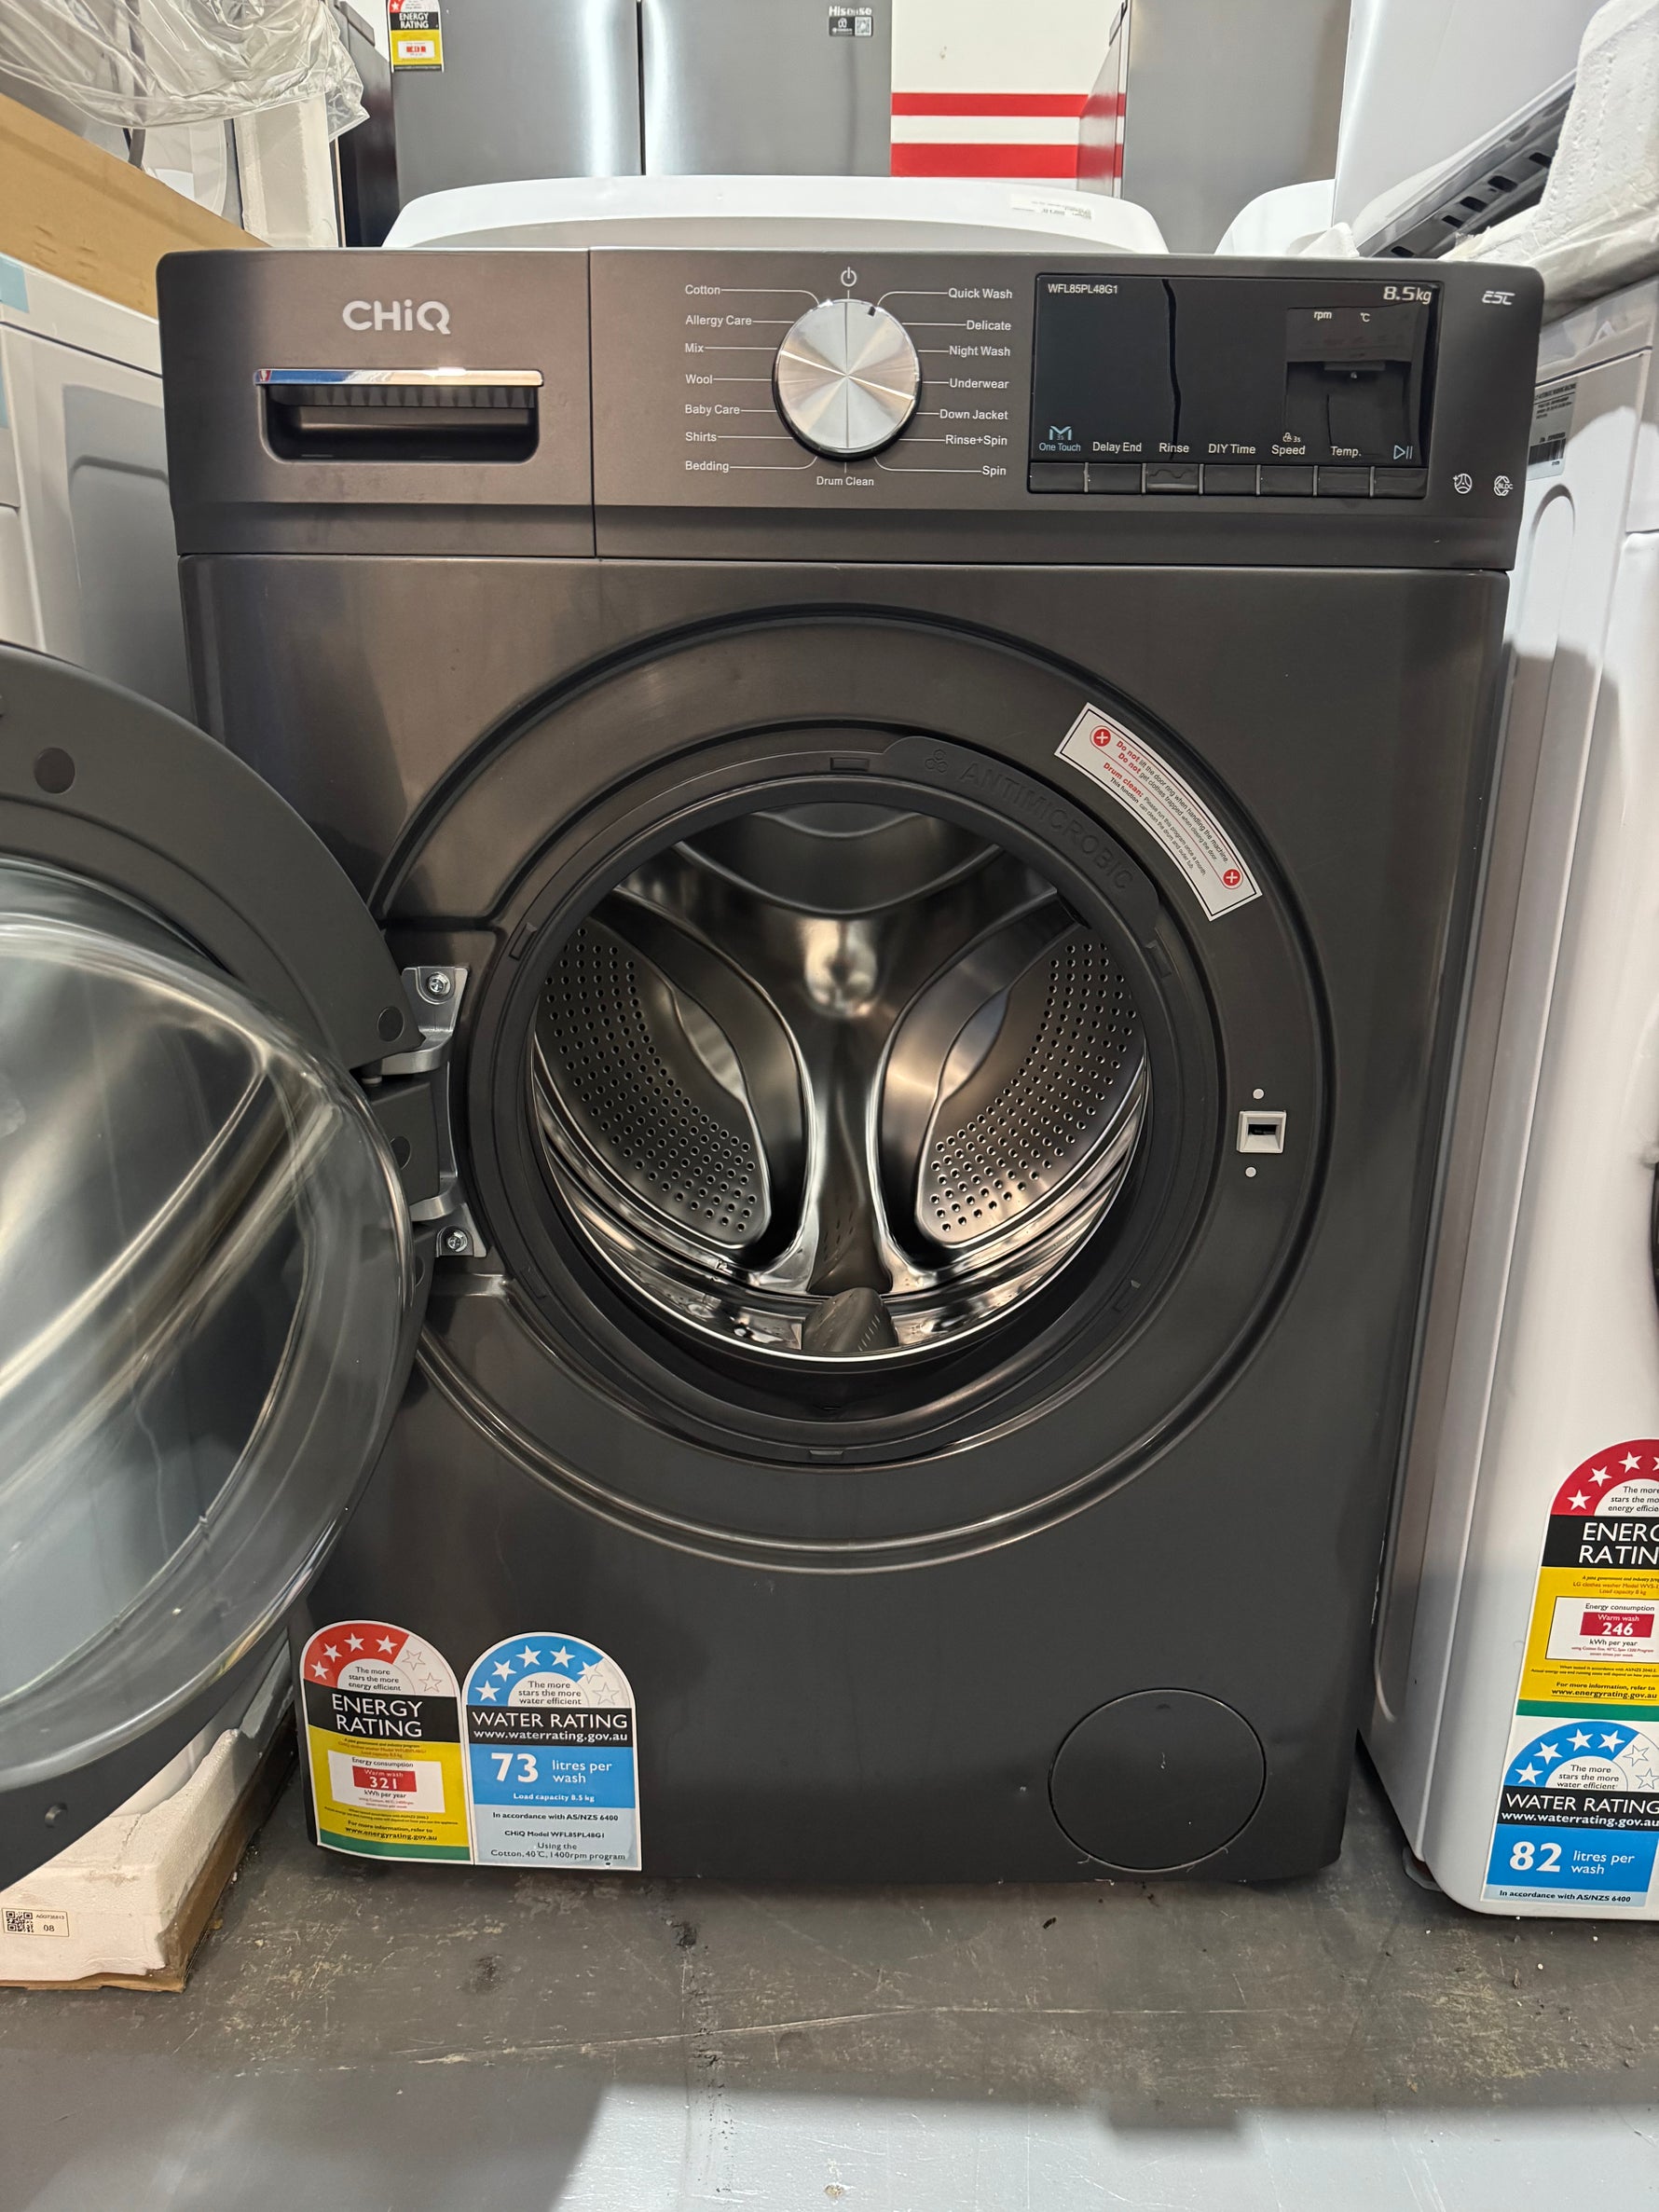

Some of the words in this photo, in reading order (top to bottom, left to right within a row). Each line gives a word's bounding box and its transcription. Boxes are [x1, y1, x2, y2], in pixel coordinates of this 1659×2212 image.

[401, 21, 429, 29] RATING
[685, 284, 720, 295] Cotton
[948, 289, 980, 300] Quick
[981, 289, 1013, 299] Wash
[1048, 283, 1117, 294] WFL85PL48G1
[1383, 286, 1432, 304] 8.5kg
[342, 299, 451, 335] CHiQ
[685, 315, 722, 328] Allergy
[725, 315, 752, 326] Care
[1314, 310, 1332, 321] rpm
[967, 320, 1011, 331] Delicate
[685, 343, 704, 353] Mix
[949, 346, 977, 357] Night
[980, 346, 1010, 357] Wash
[685, 375, 713, 384] Wool
[949, 378, 1009, 389] Underwear
[685, 405, 712, 417] Baby
[715, 405, 740, 415] Care
[939, 409, 970, 419] Down
[972, 410, 1008, 420] Jacket
[685, 433, 717, 442] Shirts
[945, 434, 1008, 447] Rinse+Spin
[1039, 443, 1056, 451] One
[1058, 443, 1081, 451] Touch
[1092, 441, 1120, 454] Delay
[1122, 442, 1142, 452] End
[1159, 443, 1190, 453] Rinse
[1208, 444, 1228, 454] DIY
[1230, 444, 1255, 454] Time
[1271, 445, 1306, 457] Speed
[1331, 446, 1362, 458] Temp.
[685, 460, 729, 474] Bedding
[982, 466, 1007, 477] Spin
[816, 476, 843, 486] Drum
[845, 476, 874, 487] Clean
[1104, 763, 1122, 779] Drum
[1122, 778, 1144, 798] clean:
[1118, 753, 1129, 763] Do
[1128, 763, 1141, 774] not
[1139, 773, 1149, 781] get
[1148, 780, 1166, 798] clothes
[1110, 777, 1121, 788] This
[1120, 786, 1139, 804] function
[1116, 740, 1127, 751] Do
[1127, 750, 1140, 762] not
[1145, 765, 1155, 776] the
[1154, 774, 1166, 786] door
[1165, 785, 1175, 797] ring
[1174, 795, 1188, 810] when
[1186, 808, 1206, 831] handling
[1204, 829, 1213, 840] the
[1579, 1546, 1659, 1565] RATIN
[1602, 1622, 1633, 1636] 246
[356, 1666, 369, 1674] The
[349, 1683, 371, 1691] energy
[1552, 1689, 1657, 1699] www.energyrating.gov.au
[332, 1693, 423, 1717] ENERGY
[336, 1713, 422, 1738] RATING
[472, 1711, 543, 1727] WATER
[551, 1714, 627, 1729] RATING
[473, 1730, 628, 1743] www.waterrating.gov.au
[352, 1757, 372, 1765] Energy
[374, 1760, 414, 1768] consumption
[491, 1752, 539, 1783] 73
[552, 1760, 586, 1771] litres
[589, 1763, 612, 1774] per
[369, 1776, 397, 1790] 321
[552, 1773, 586, 1783] wash
[585, 1794, 595, 1803] kg
[1505, 1793, 1576, 1812] WATER
[1584, 1797, 1659, 1815] RATING
[1501, 1812, 1659, 1828] www.waterrating.gov.au
[345, 1827, 437, 1840] www.energyrating.gov.au
[550, 1851, 587, 1861] 1400rpm
[589, 1852, 625, 1862] program
[1509, 1841, 1562, 1873] 82
[1573, 1850, 1607, 1862] litres
[1611, 1854, 1635, 1865] per
[1570, 1863, 1605, 1875] wash
[1509, 1890, 1556, 1899] accordance
[1576, 1893, 1610, 1902] AS/NZS
